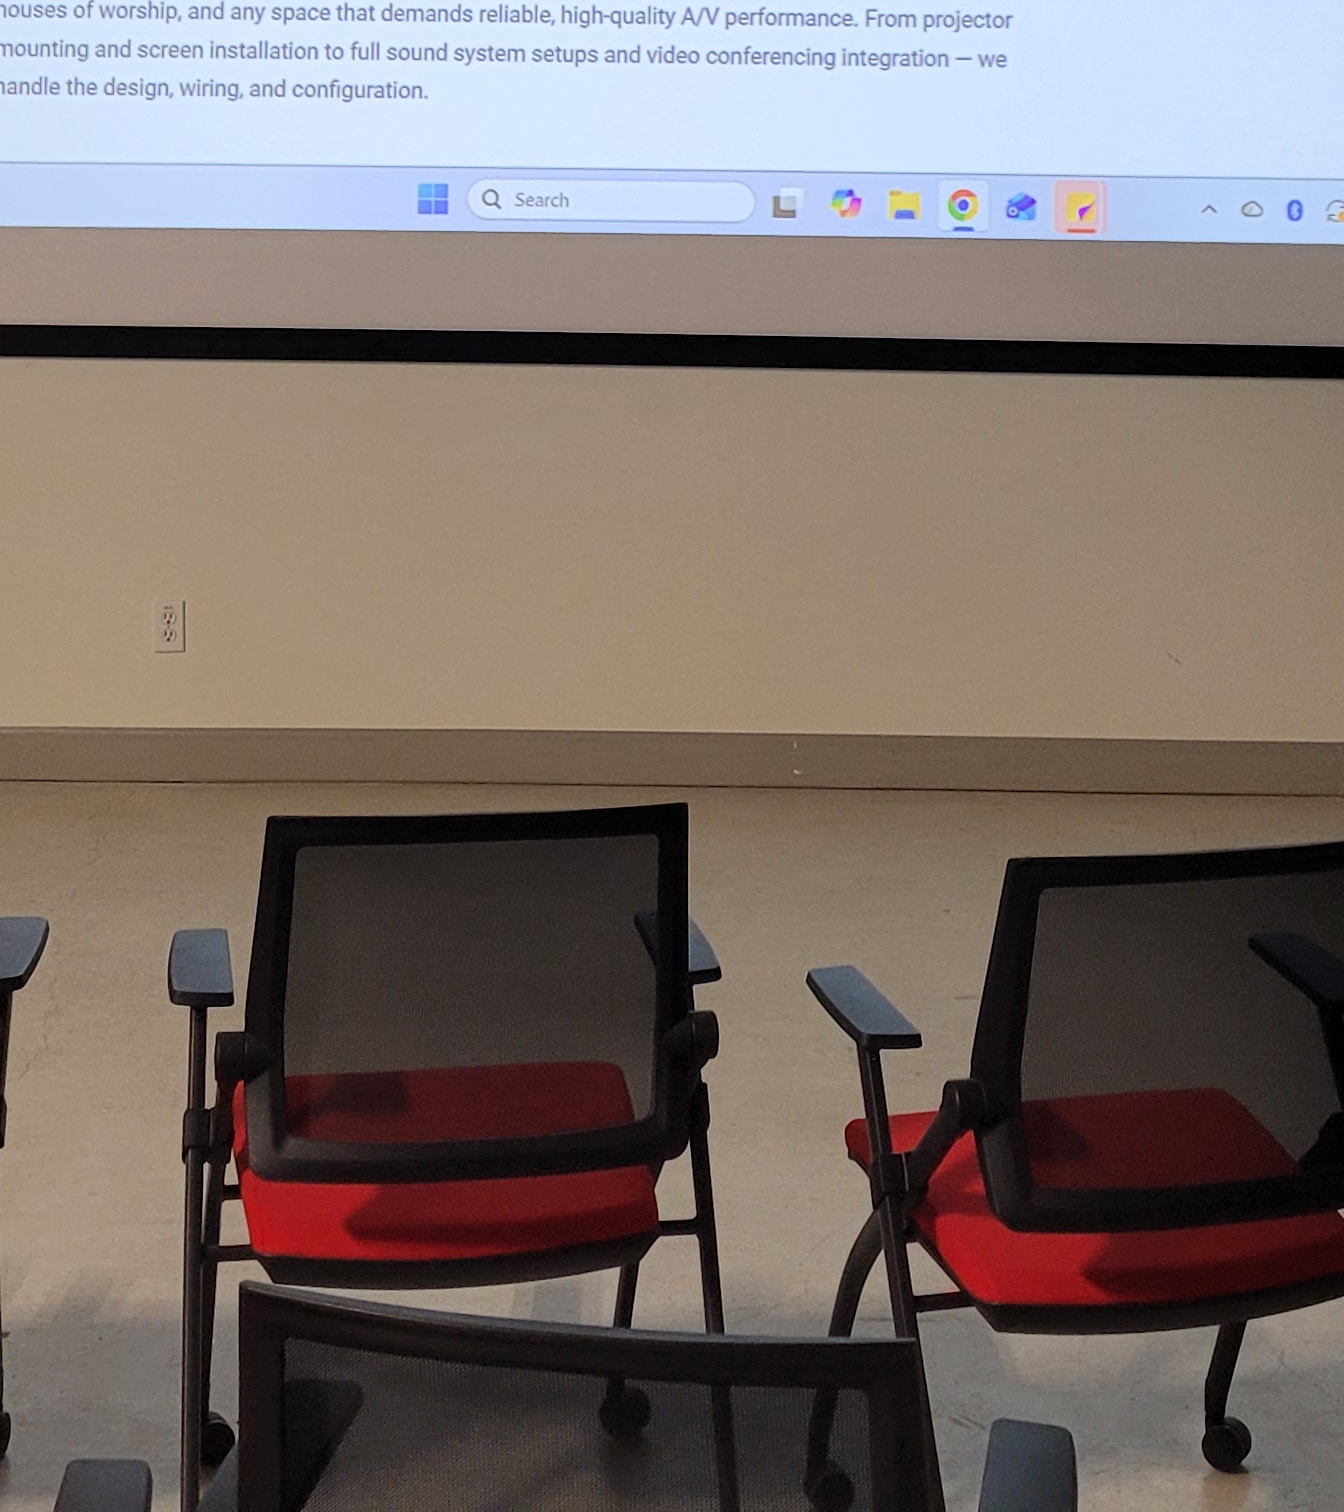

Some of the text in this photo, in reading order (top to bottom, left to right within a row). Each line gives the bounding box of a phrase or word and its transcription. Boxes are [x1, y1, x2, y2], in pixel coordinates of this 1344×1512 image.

[99, 0, 181, 25] worship,
[188, 0, 224, 20] and
[231, 5, 265, 25] any
[271, 6, 330, 27] space
[336, 2, 375, 22] that
[381, 2, 473, 23] demands
[480, 3, 555, 26] reliable,
[562, 4, 676, 30] high-quality
[681, 7, 720, 27] A/V
[725, 5, 858, 32] performance.
[866, 8, 916, 29] From
[923, 10, 1013, 34] projector
[95, 39, 131, 58] and
[138, 43, 203, 59] screen
[210, 39, 318, 60] installation
[324, 43, 344, 61] to
[351, 41, 380, 61] full
[387, 41, 447, 62] sound
[454, 45, 525, 67] system
[532, 46, 598, 68] setups
[604, 44, 640, 64] and
[647, 44, 700, 65] video
[706, 45, 836, 71] conferencing
[842, 48, 949, 72] integration
[978, 53, 1007, 69] we
[66, 76, 97, 96] the
[104, 77, 173, 101] design,
[180, 79, 243, 102] wiring,
[250, 78, 286, 98] and
[292, 78, 428, 104] configuration.
[515, 192, 569, 208] Search
